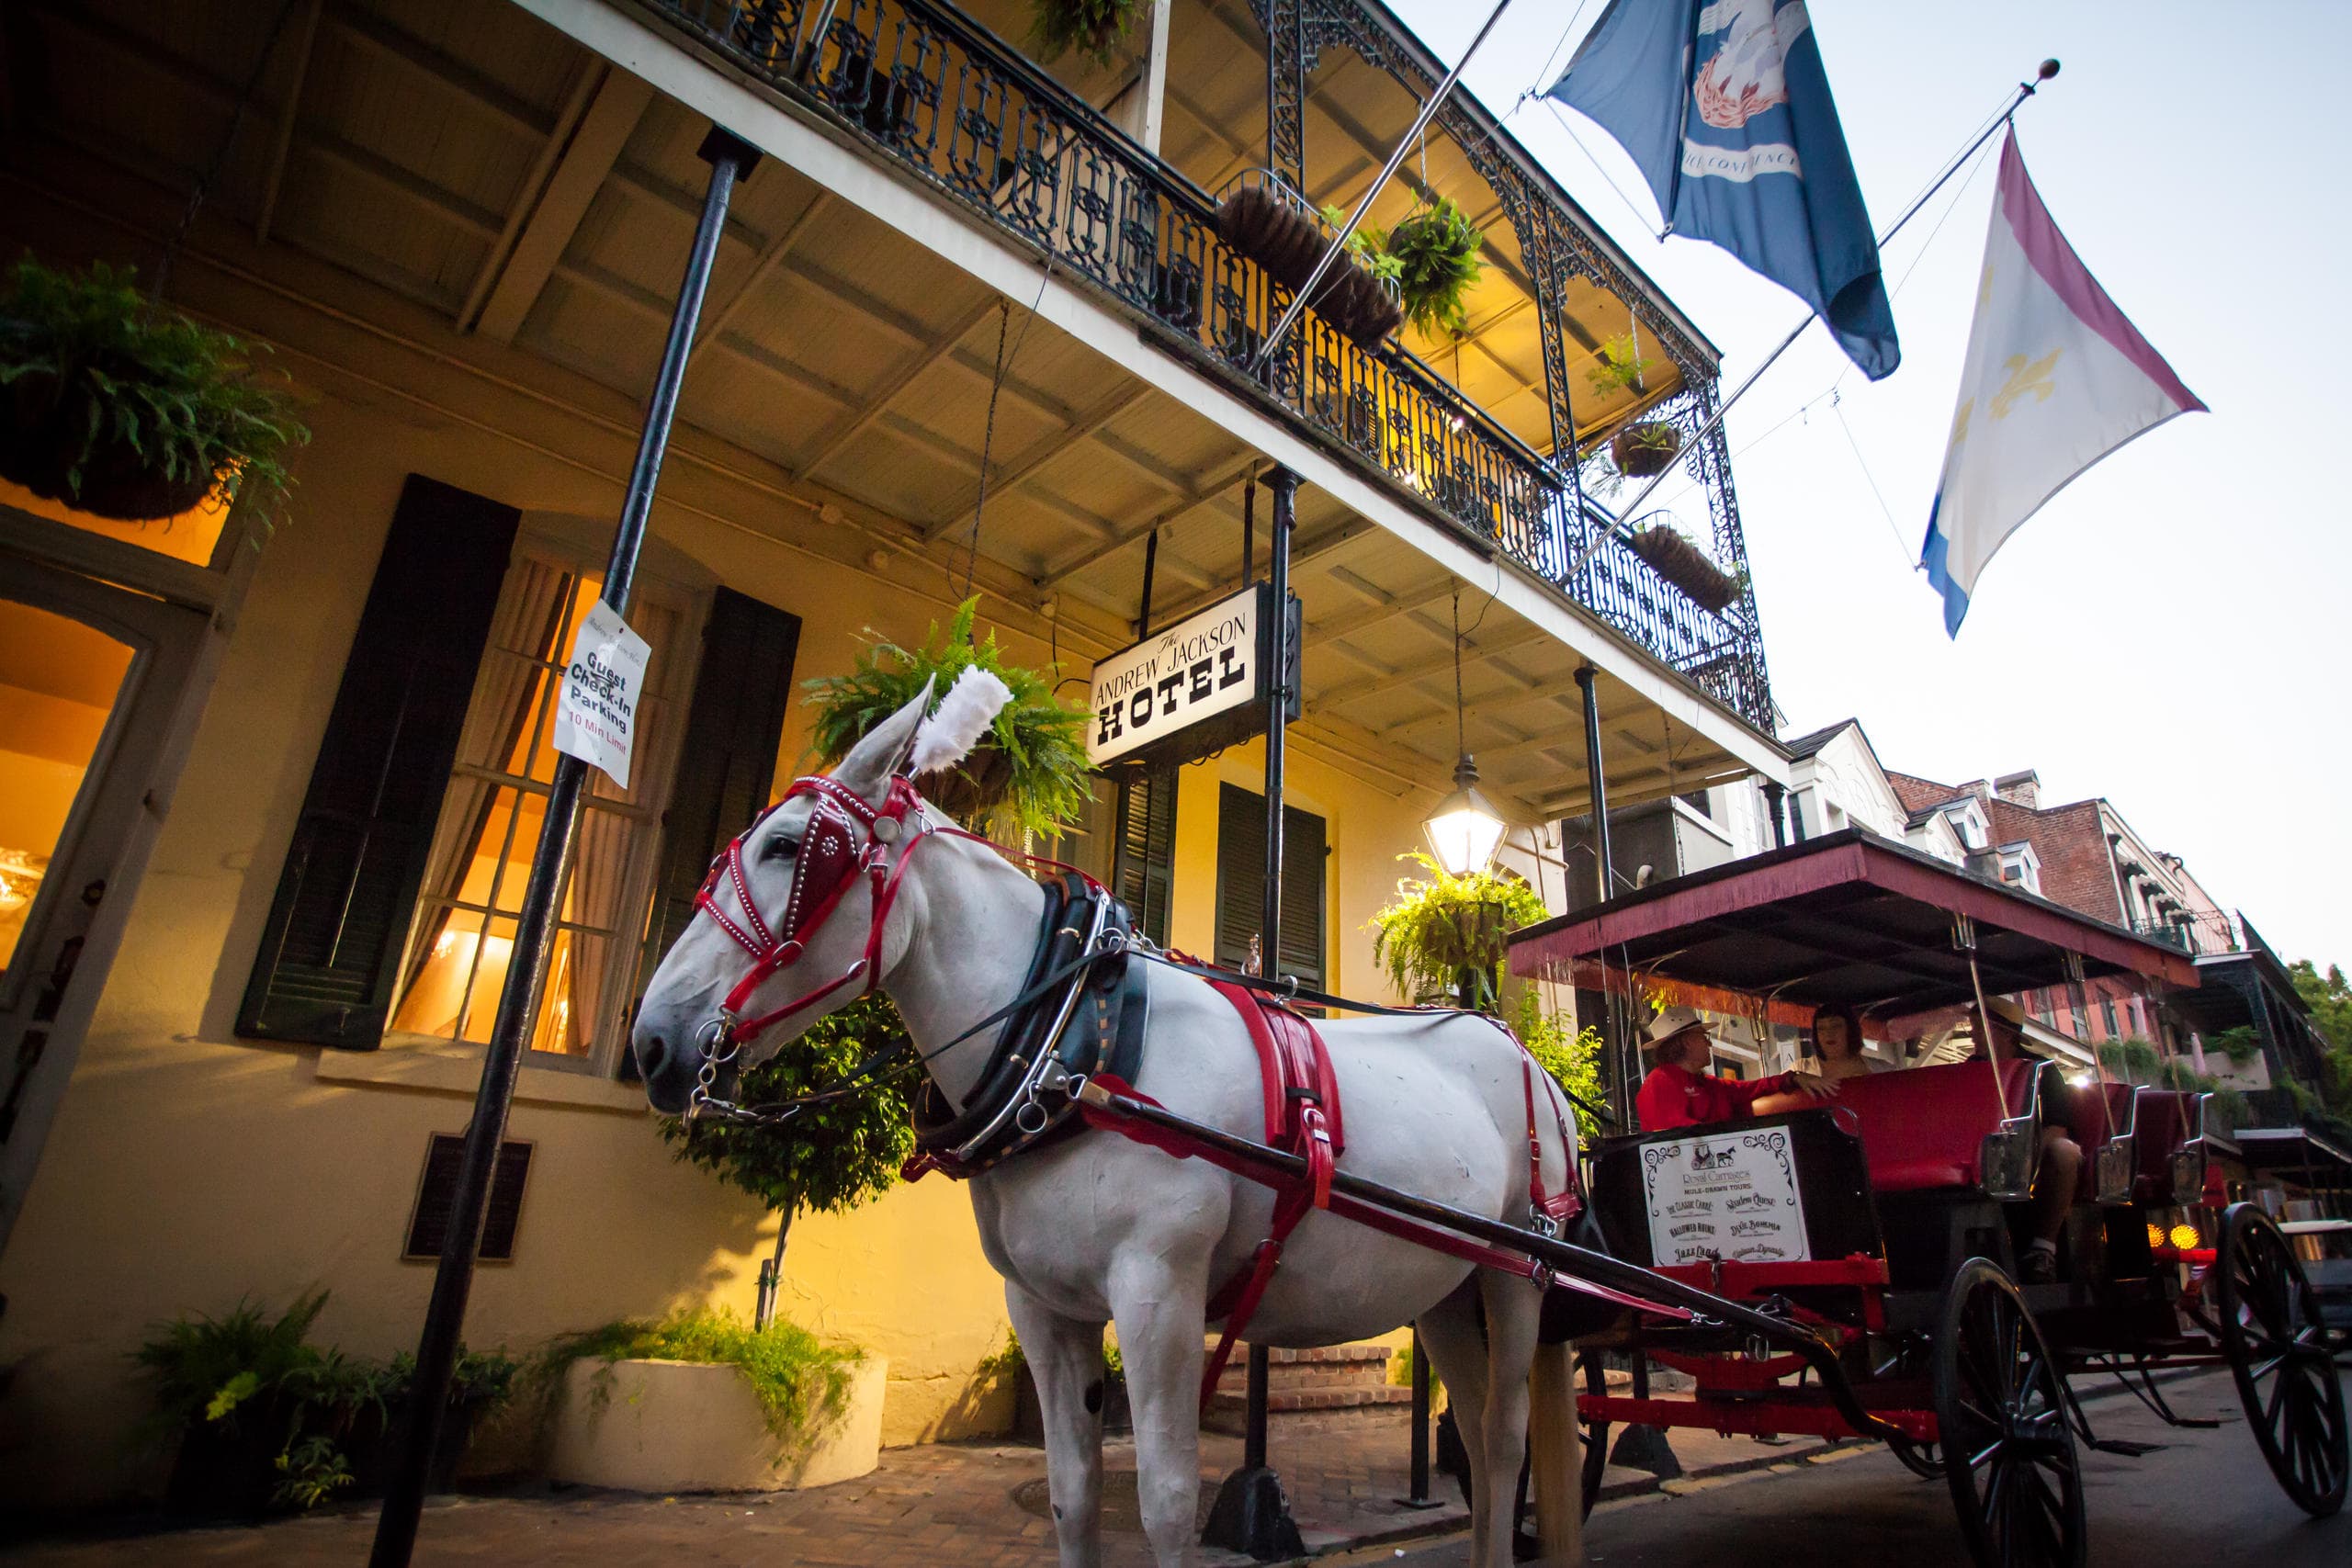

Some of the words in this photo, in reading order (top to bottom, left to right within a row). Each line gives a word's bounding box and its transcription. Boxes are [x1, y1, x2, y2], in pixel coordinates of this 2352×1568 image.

[1094, 656, 1160, 708] ANDREW
[1167, 613, 1246, 671] JACKSON
[1157, 631, 1181, 654] The
[571, 663, 631, 717] Check-In
[586, 651, 627, 692] Guest
[570, 684, 627, 735] Parking
[1097, 645, 1246, 747] HOTEL
[569, 711, 582, 726] 10
[585, 718, 605, 739] Min
[606, 732, 627, 756] Limit
[1682, 1172, 1707, 1184] Royal
[1708, 1169, 1750, 1183] Carriages
